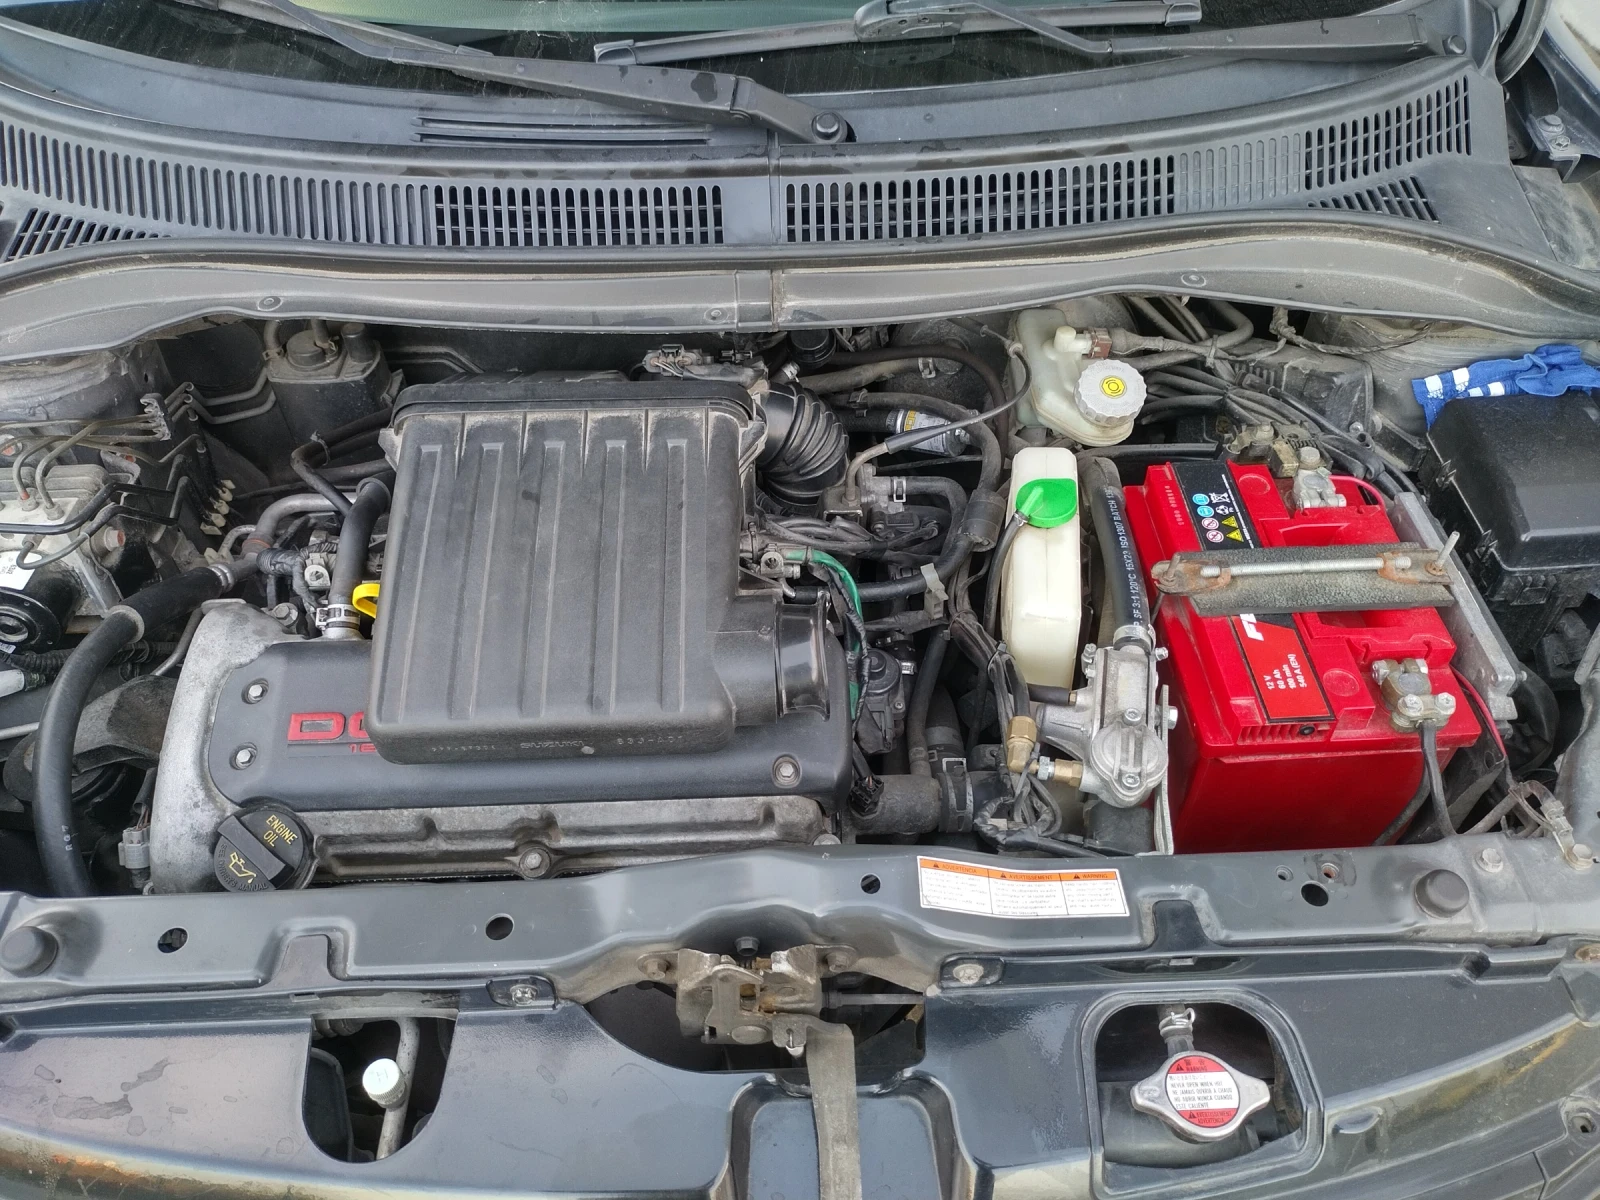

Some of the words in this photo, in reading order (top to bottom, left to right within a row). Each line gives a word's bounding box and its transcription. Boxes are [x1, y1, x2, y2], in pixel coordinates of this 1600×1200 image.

[1109, 500, 1122, 521] BATCH
[1115, 521, 1125, 535] 1307
[1119, 535, 1129, 549] ISO
[1131, 595, 1141, 608] 3:1
[1133, 609, 1142, 618] SF
[1287, 653, 1301, 669] (EN)
[1273, 669, 1282, 679] Ah
[1282, 664, 1292, 677] min
[1265, 681, 1275, 690] 12
[1277, 680, 1286, 689] 60
[1296, 675, 1307, 688] 540
[266, 814, 298, 845] ENGINE
[263, 830, 279, 847] OIL
[942, 863, 977, 874] ADVERTENCIA
